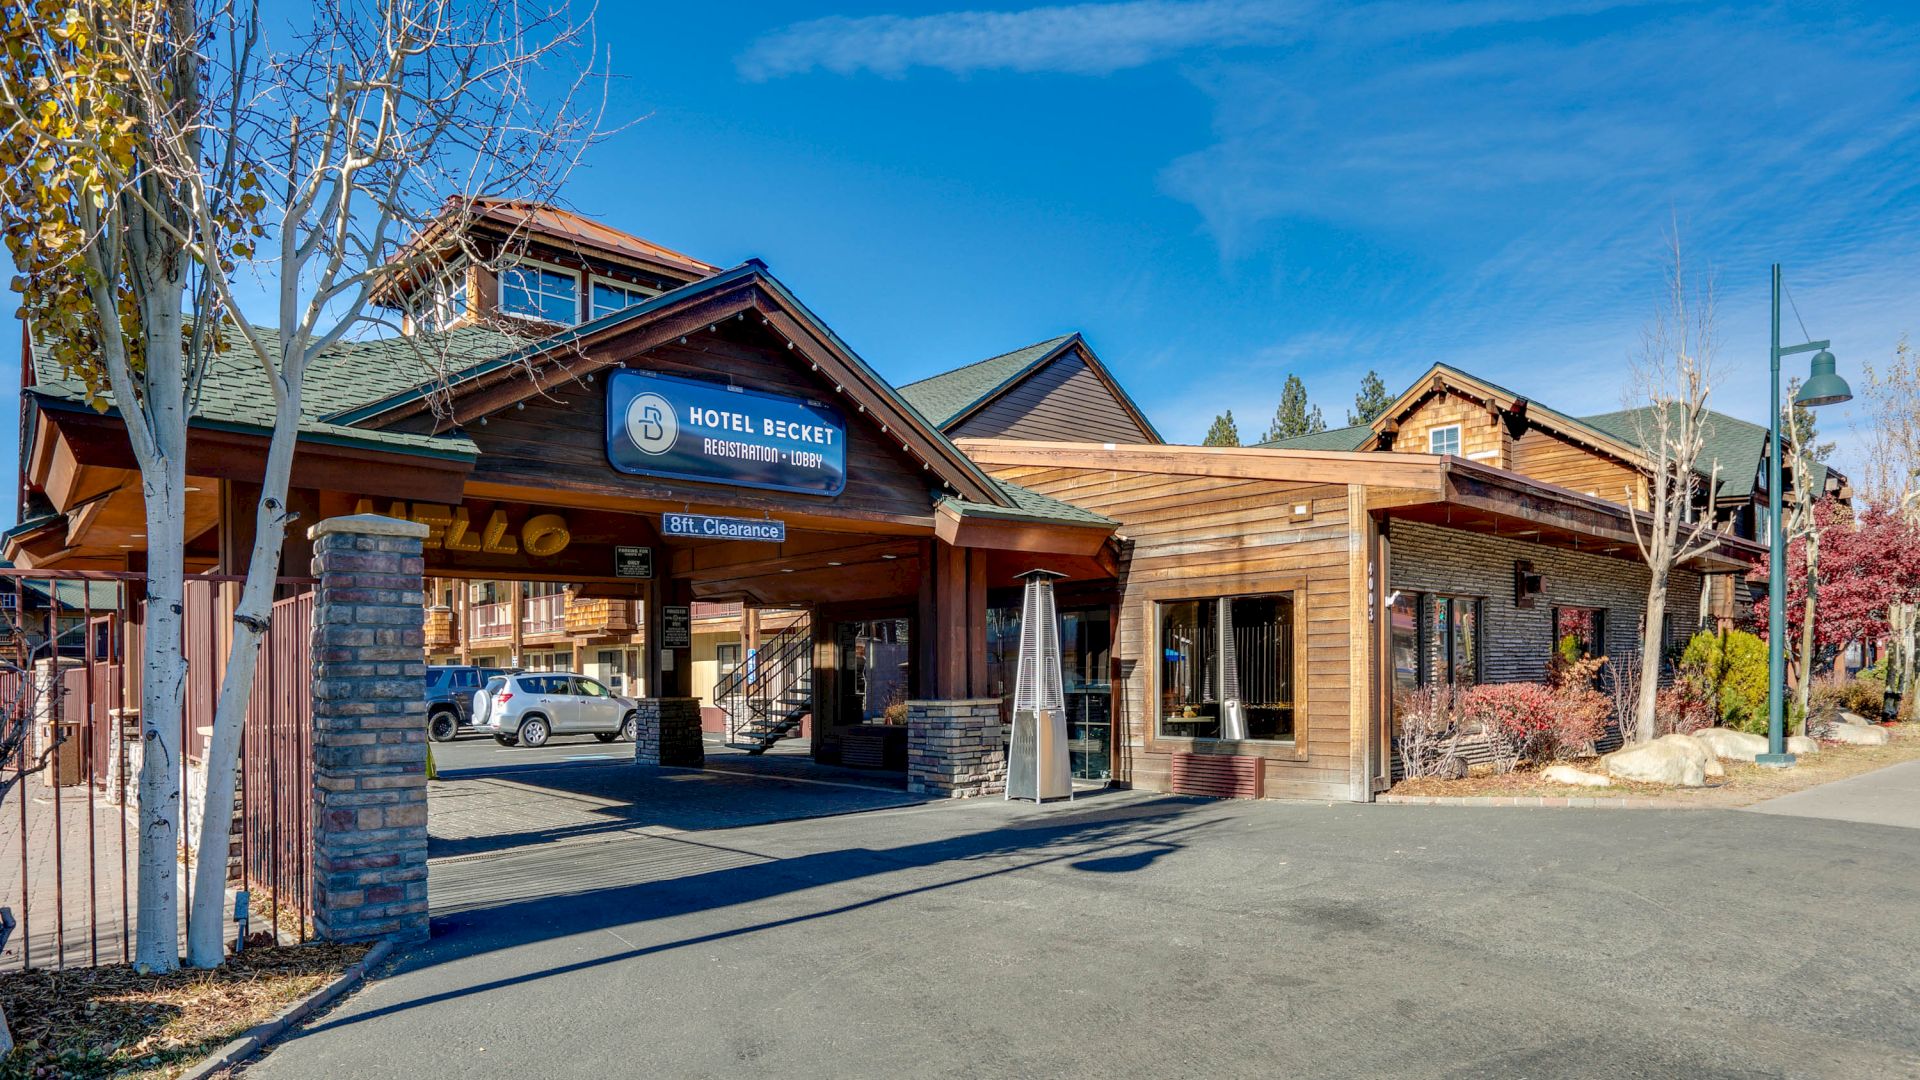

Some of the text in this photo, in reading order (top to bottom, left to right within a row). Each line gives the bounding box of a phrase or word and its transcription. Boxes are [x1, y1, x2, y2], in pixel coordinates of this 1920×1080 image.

[689, 406, 834, 445] HOTEL BECKET
[704, 437, 823, 469] REGISTRATION LOBBY
[354, 499, 571, 556] ELLO
[670, 516, 779, 538] 8ft. Clearance
